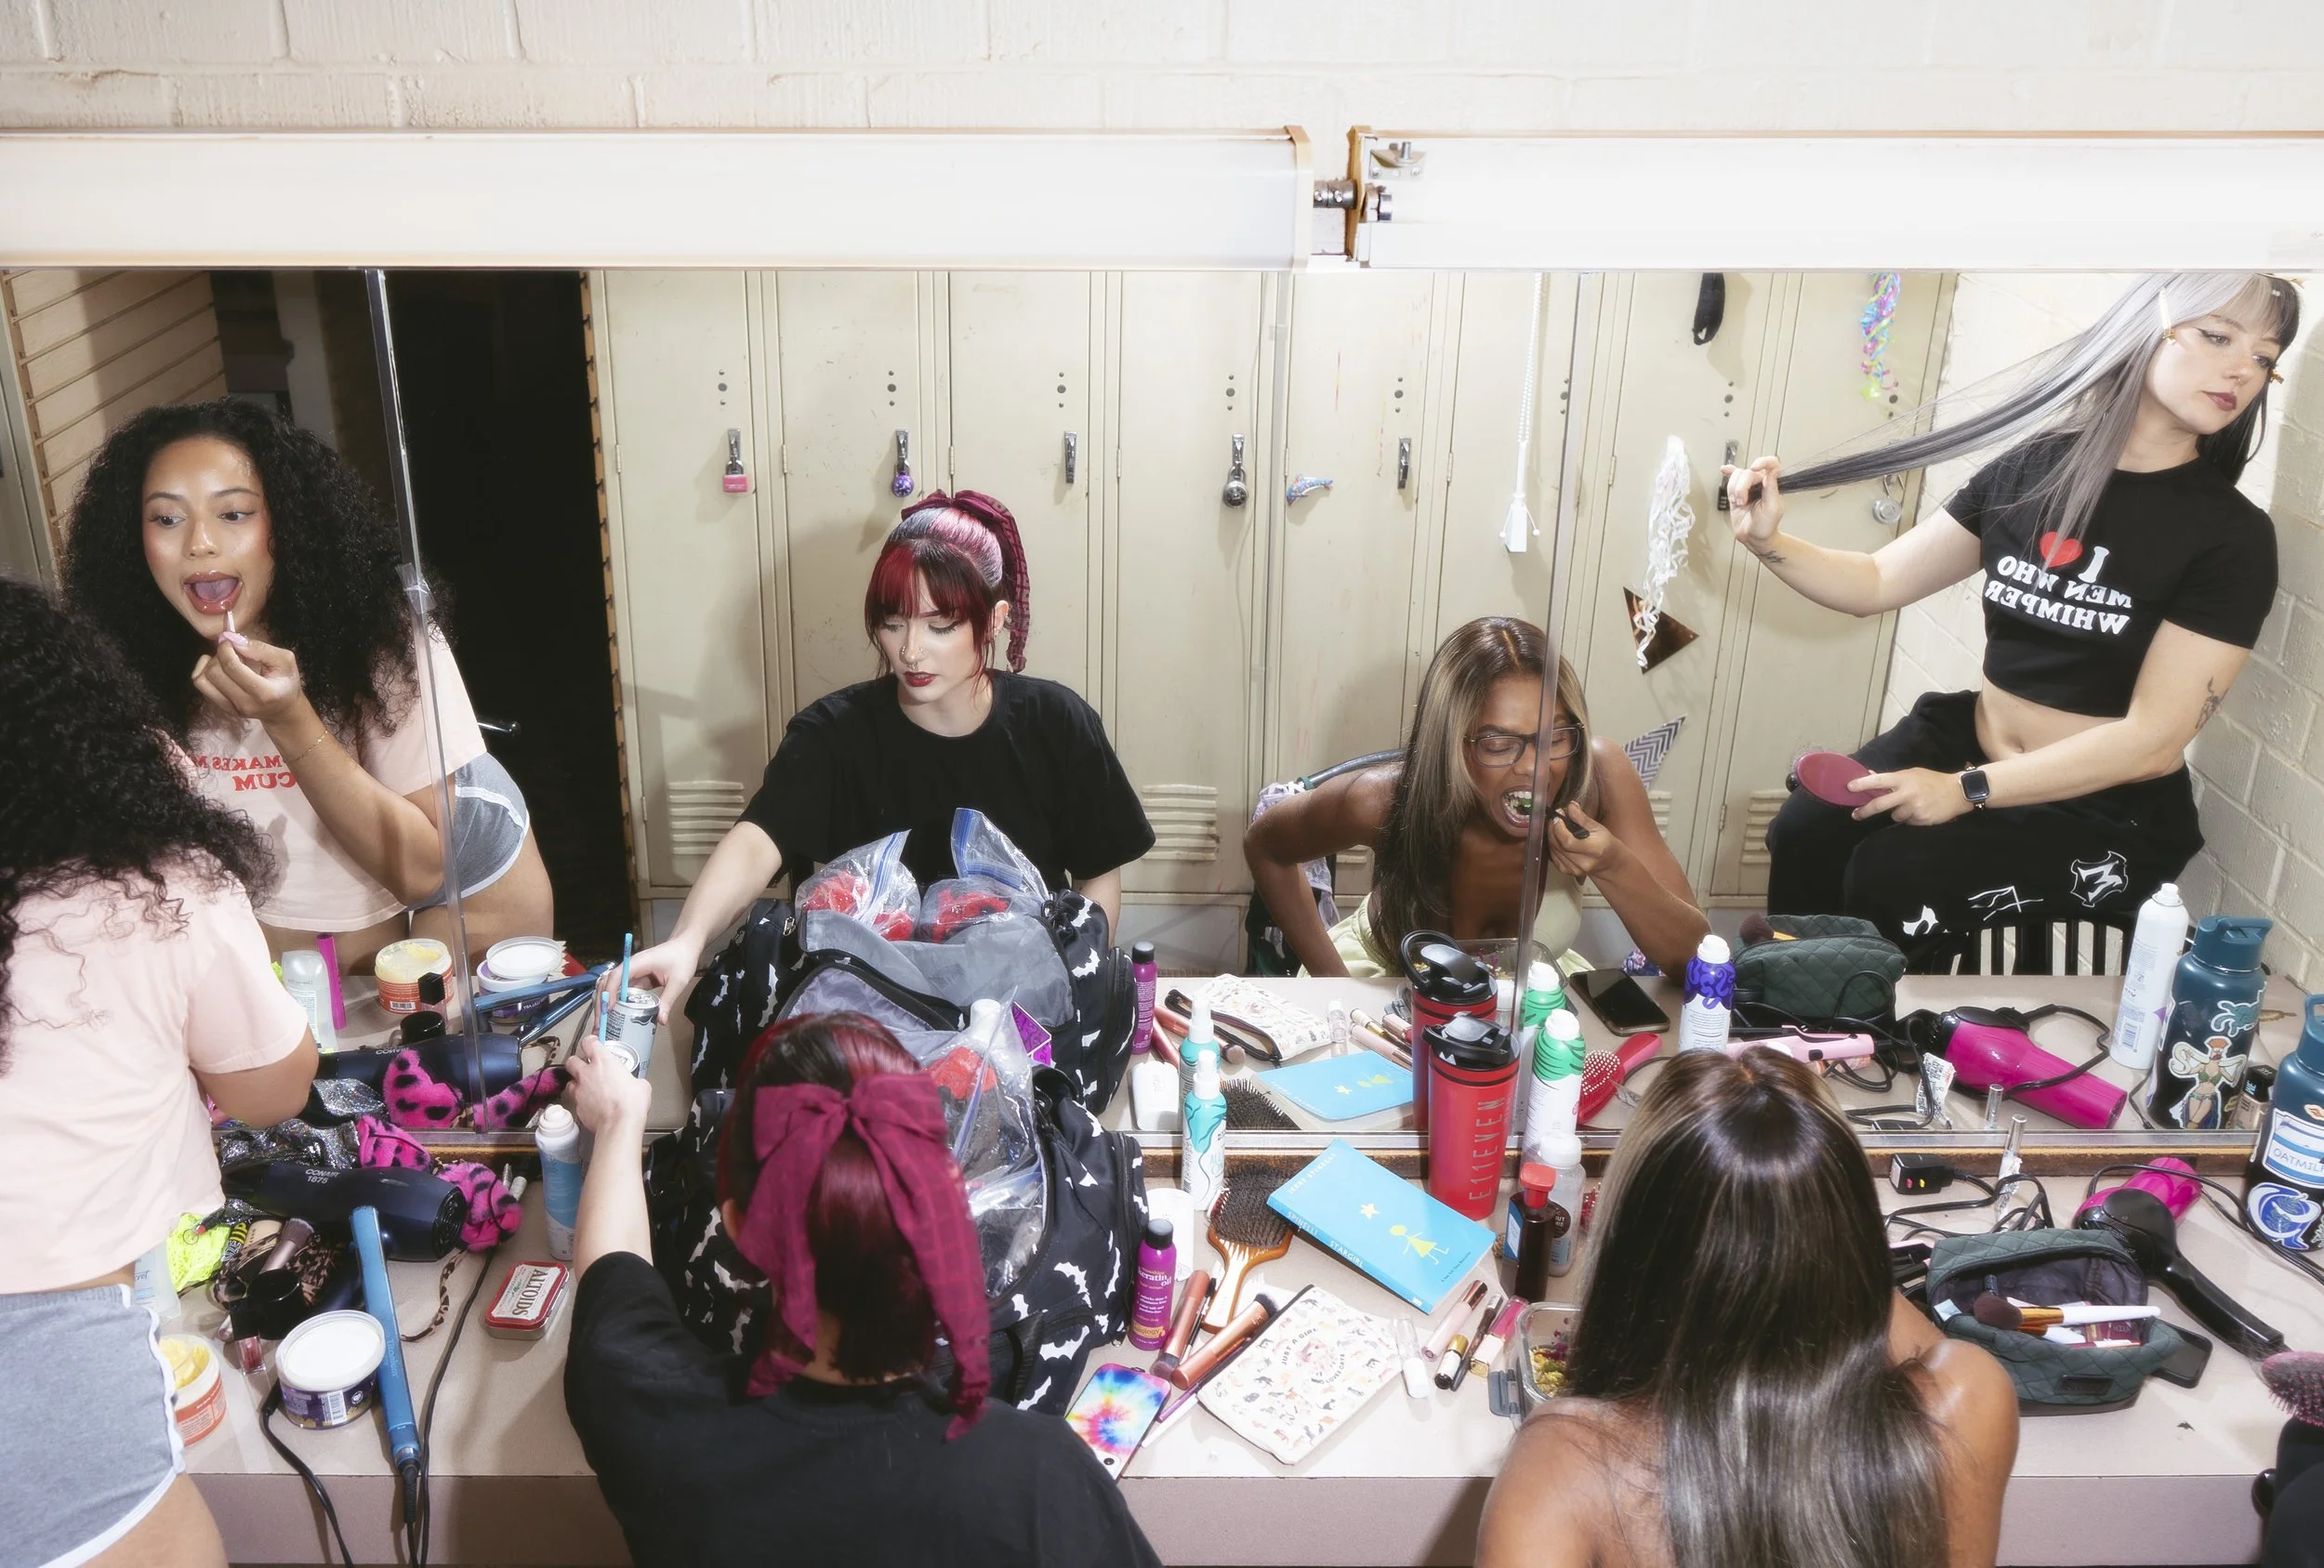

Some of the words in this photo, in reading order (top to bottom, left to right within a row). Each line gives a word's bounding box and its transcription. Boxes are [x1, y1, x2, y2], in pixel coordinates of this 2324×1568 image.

[305, 1168, 339, 1179] CONAIR
[307, 1176, 329, 1184] 1875
[1287, 1211, 1319, 1236] SPINELLI
[1328, 1240, 1365, 1269] STARGIRL
[1138, 1265, 1168, 1281] keratin
[1161, 1275, 1172, 1286] oil
[511, 1269, 548, 1316] ALTOIDS
[386, 1339, 398, 1377] Titanium
[1281, 1345, 1292, 1366] JUST
[1299, 1327, 1318, 1339] GIRL
